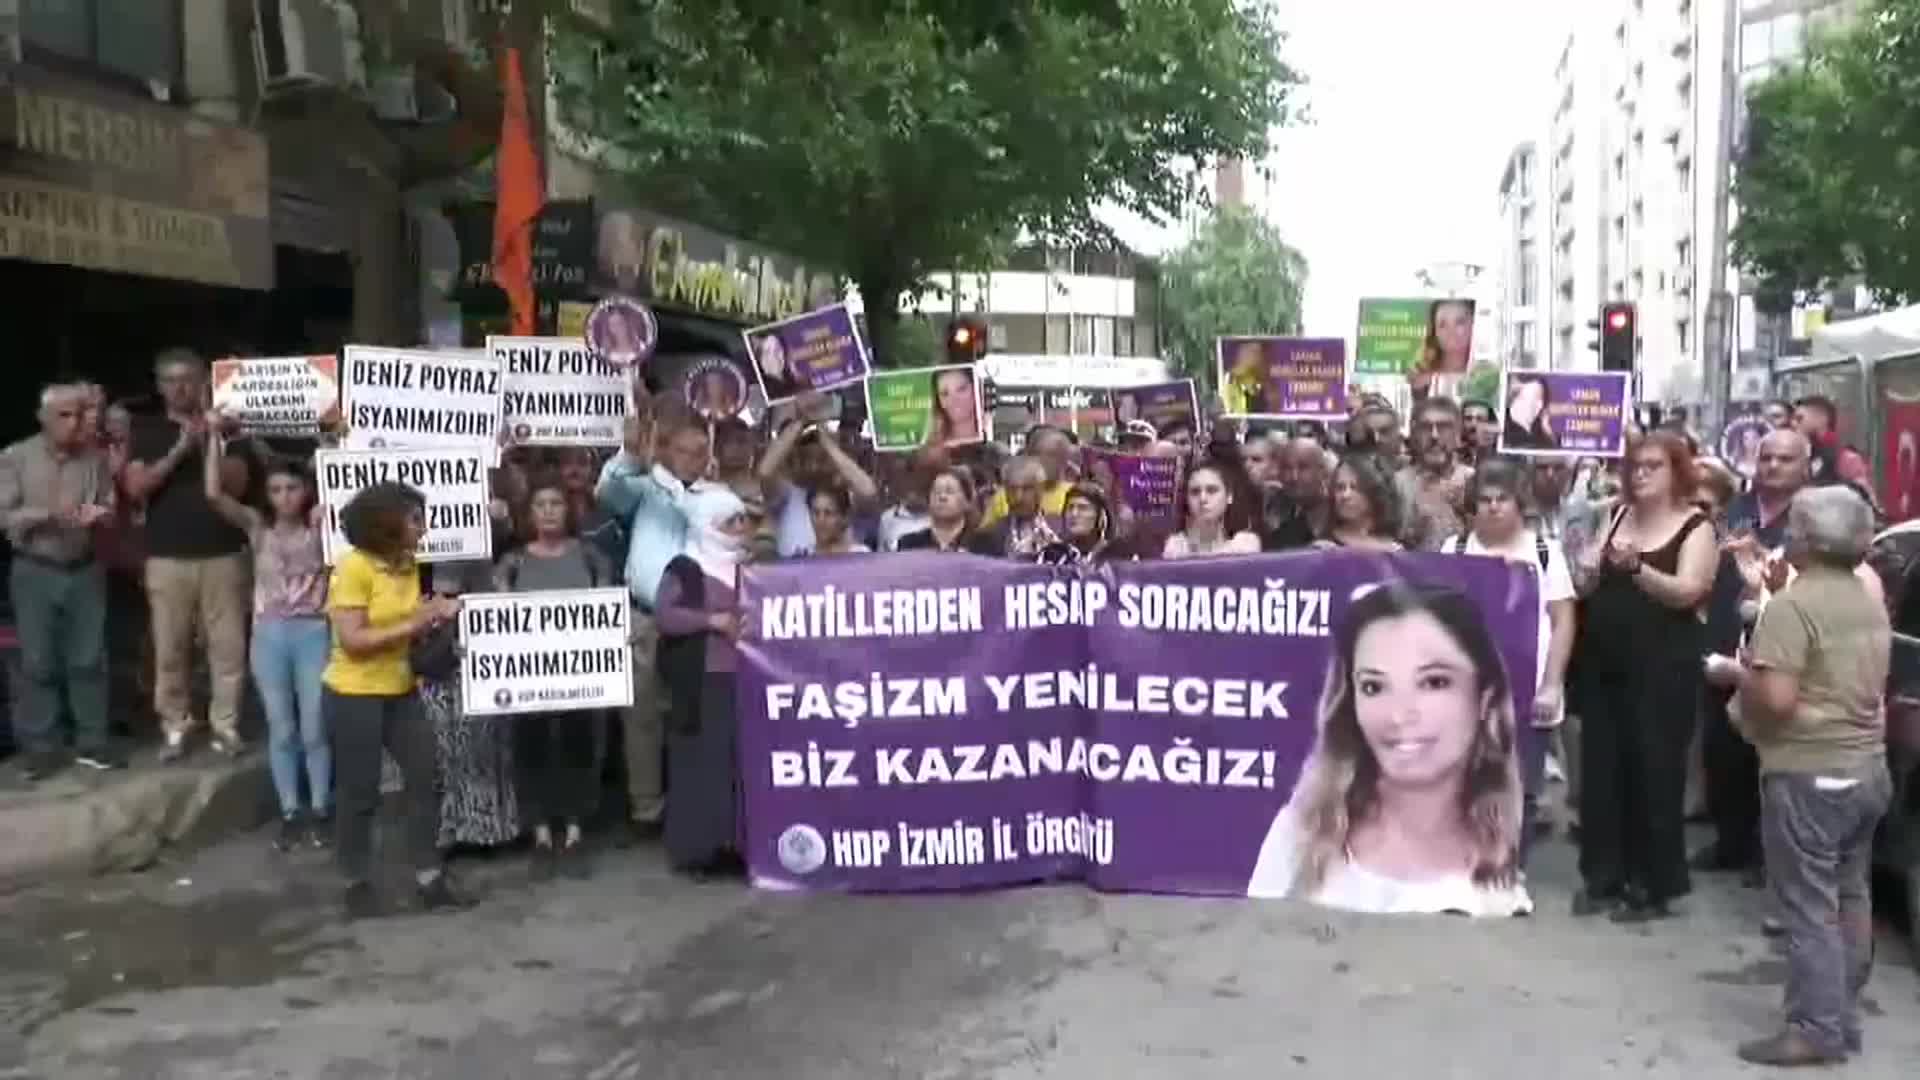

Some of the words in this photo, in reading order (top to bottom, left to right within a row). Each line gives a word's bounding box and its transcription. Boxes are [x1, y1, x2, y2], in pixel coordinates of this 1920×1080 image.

[353, 359, 413, 389] DENİZ
[420, 364, 498, 395] POYRAZ
[351, 399, 495, 437] İSYANIMIZDIR!
[503, 391, 625, 416] SYANIMIZDIR
[327, 457, 389, 490] DENİZ
[398, 458, 481, 487] POYRAZ
[469, 602, 533, 635] DENİZ
[540, 602, 625, 632] POYRAZ
[761, 584, 983, 640] KATİLLERDEN
[1005, 578, 1108, 629] HESAP
[1118, 577, 1331, 637] SORACAĞIZ!
[471, 647, 624, 681] İSYANIMIZDIR!
[766, 671, 967, 728] FAŞİZM
[984, 662, 1289, 718] YENİLECEK
[771, 741, 860, 788] BİZ
[876, 736, 1276, 789] KAZANACAĞIZ!
[832, 829, 890, 868] HDP
[898, 818, 984, 867] İZMİR
[993, 815, 1018, 862] İL
